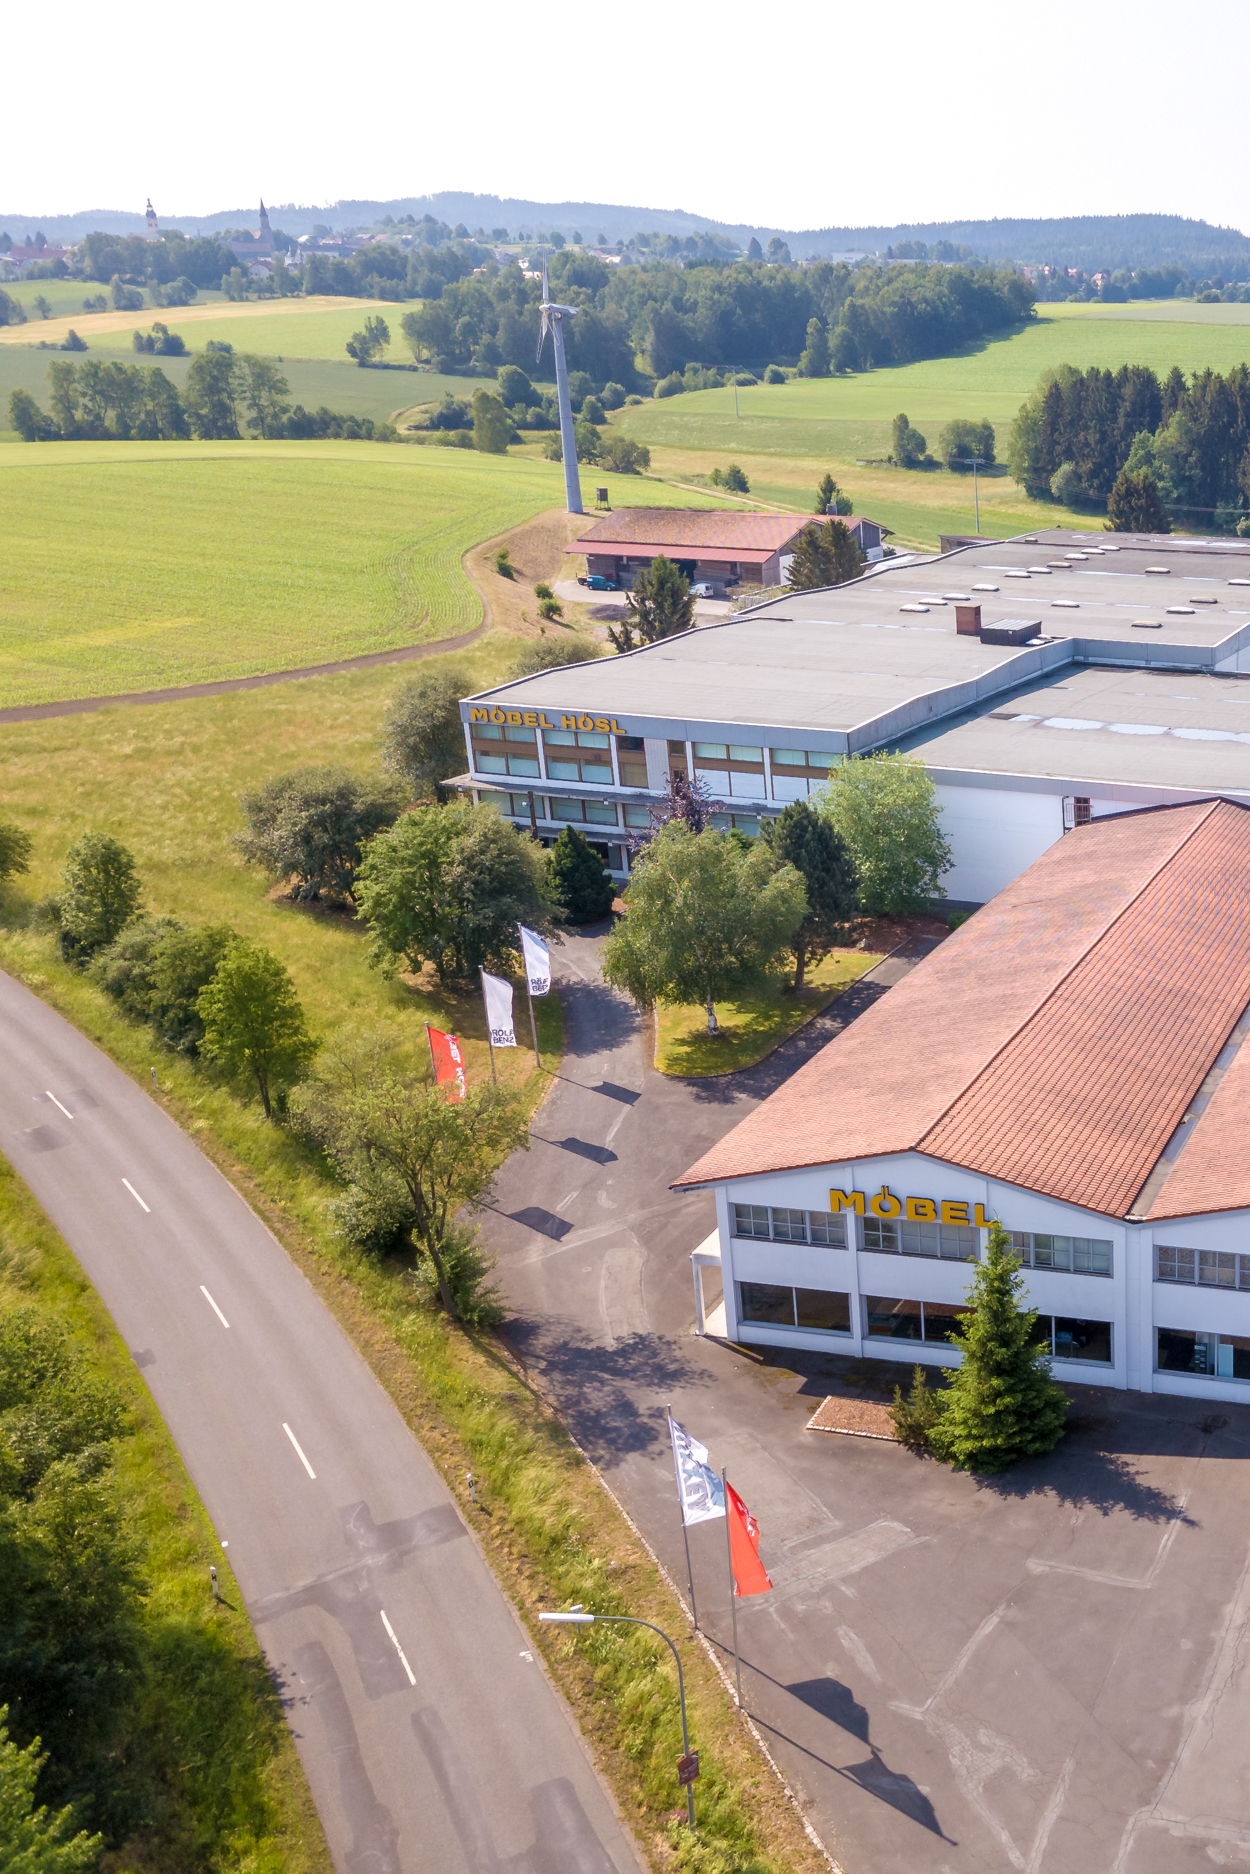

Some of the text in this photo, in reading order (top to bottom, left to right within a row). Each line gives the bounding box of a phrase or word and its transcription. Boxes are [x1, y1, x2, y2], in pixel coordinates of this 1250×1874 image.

[470, 704, 627, 734] MÖBEL HÖSL
[493, 1036, 515, 1044] BENZ
[829, 1185, 998, 1228] MÖBEL
